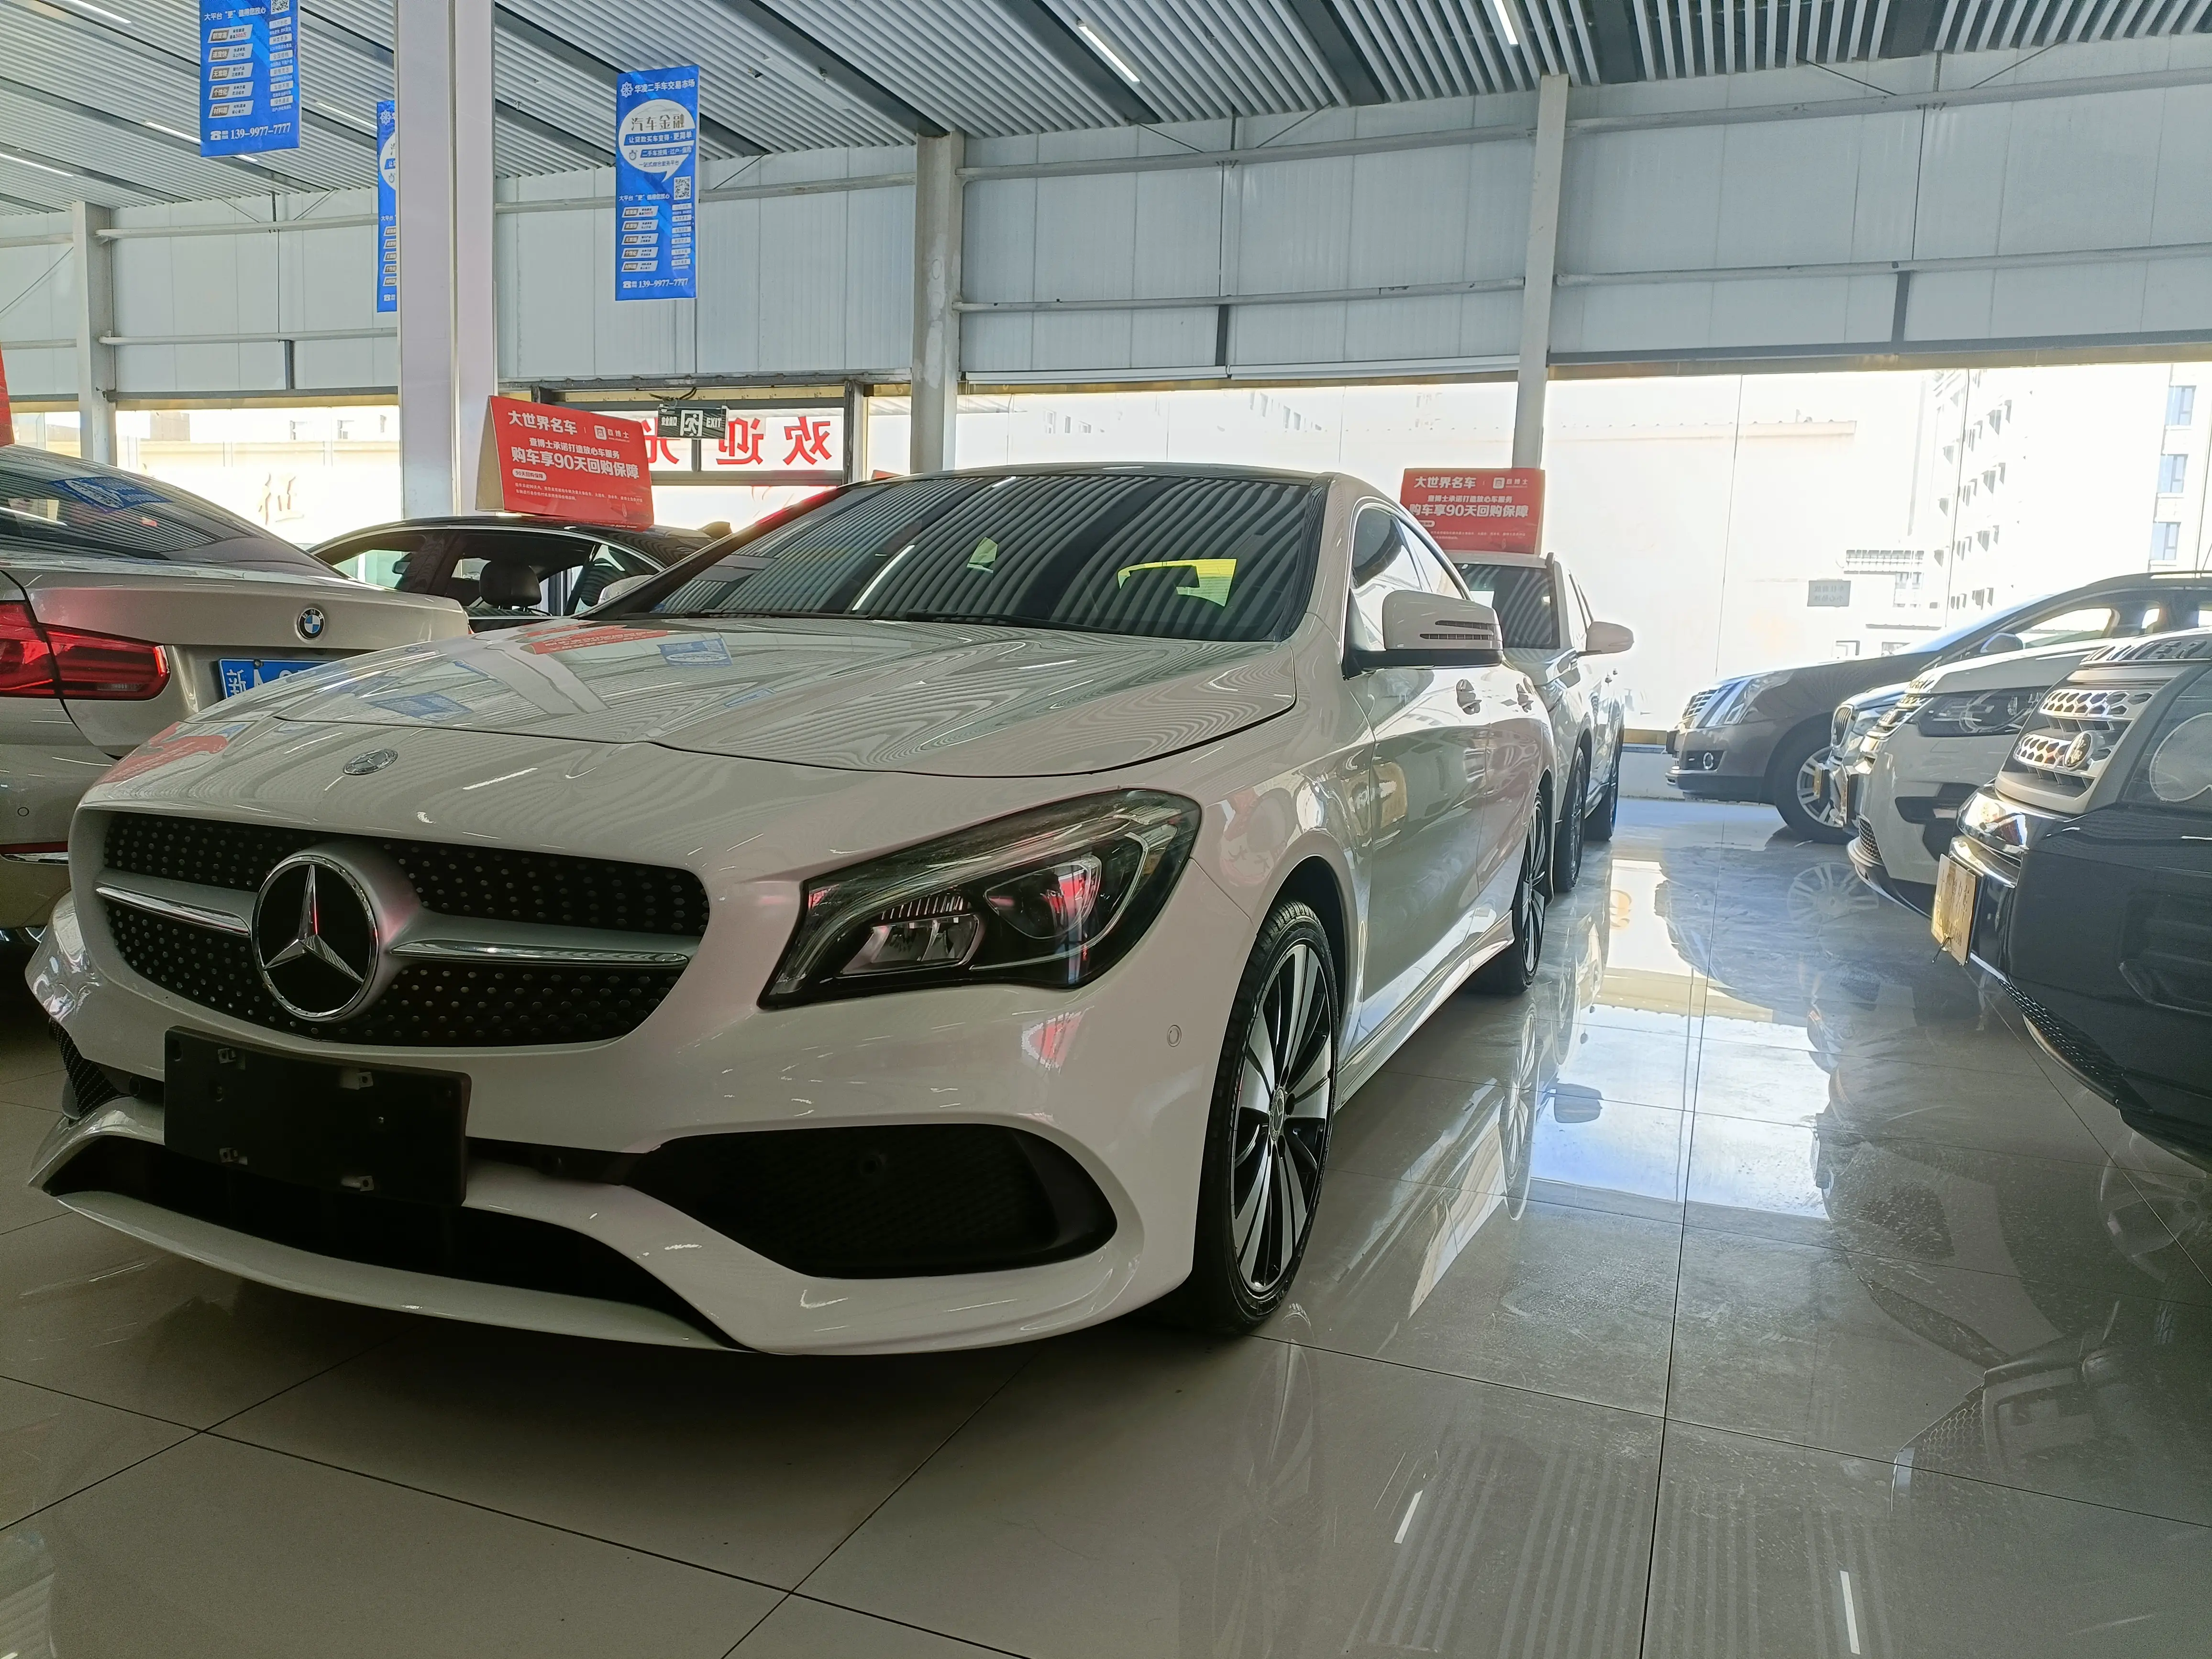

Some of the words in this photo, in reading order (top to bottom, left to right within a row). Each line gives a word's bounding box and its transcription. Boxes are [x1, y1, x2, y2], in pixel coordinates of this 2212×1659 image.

[204, 12, 222, 21] 大平台
[634, 79, 695, 93] 华凌二手车交易市场
[631, 113, 685, 132] 汽车金融
[231, 122, 291, 140] 139-9977-7777
[638, 278, 689, 288] 139-9977-7777
[507, 410, 577, 435] 大世界名车
[706, 417, 722, 428] EXIT
[529, 437, 620, 459] 查博士承诺打造放心车服务
[511, 446, 640, 479] 购车享90天回购保障
[515, 470, 543, 479] 90天回购保障
[1414, 476, 1477, 489] 大世界名车
[1409, 504, 1529, 518] 购车享90天回购保障
